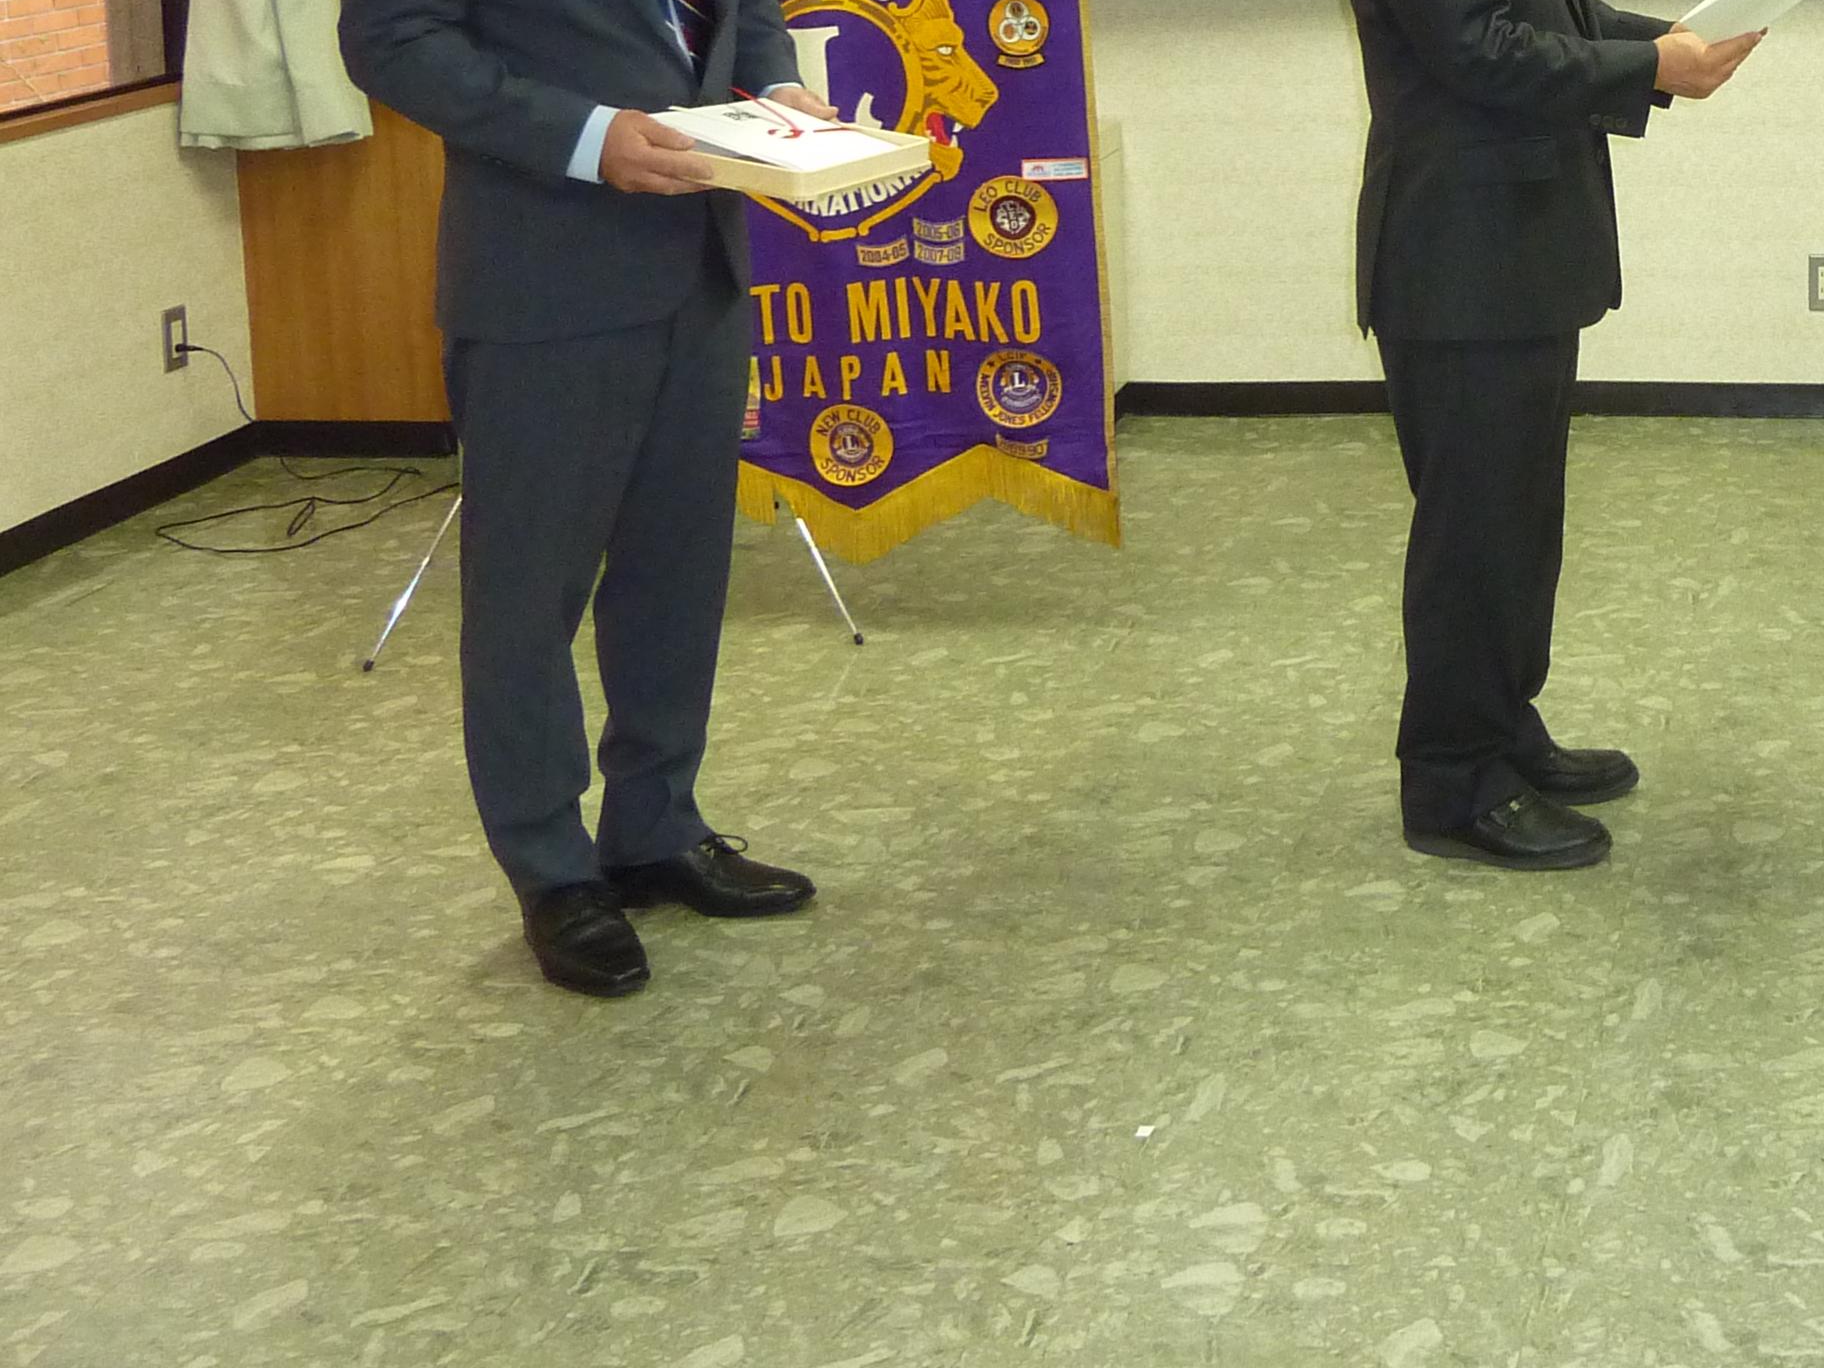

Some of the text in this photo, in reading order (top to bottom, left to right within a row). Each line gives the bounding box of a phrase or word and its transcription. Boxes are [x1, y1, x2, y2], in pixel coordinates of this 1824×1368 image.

[974, 180, 1042, 212] LEO CLUB
[983, 222, 1051, 255] SPONSOR
[846, 277, 1041, 345] MIYAKO
[763, 349, 951, 402] JAPAN
[1013, 372, 1026, 388] L
[816, 409, 881, 437] NEW CLUB
[820, 455, 885, 483] SPONSOR
